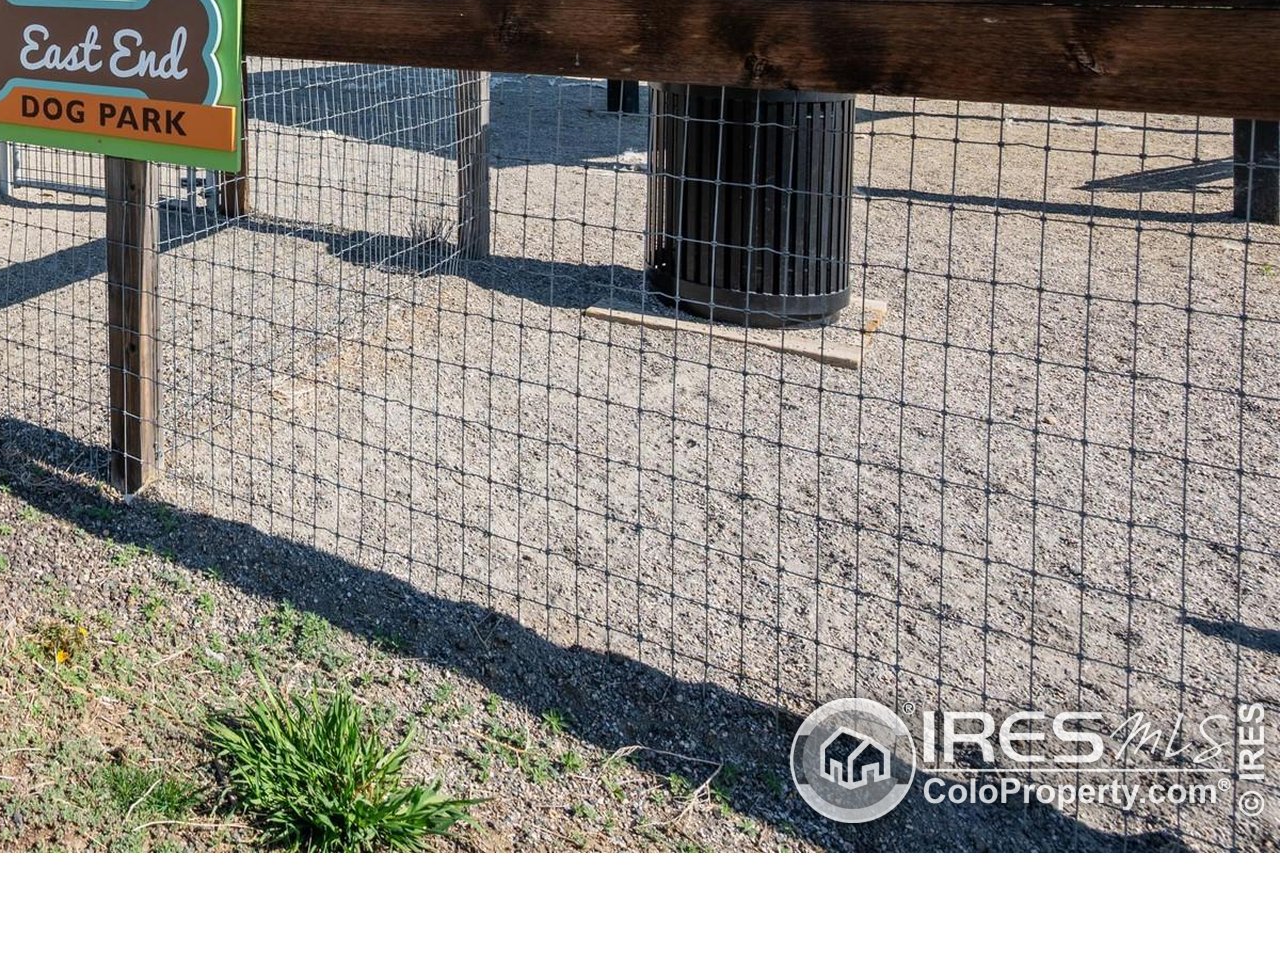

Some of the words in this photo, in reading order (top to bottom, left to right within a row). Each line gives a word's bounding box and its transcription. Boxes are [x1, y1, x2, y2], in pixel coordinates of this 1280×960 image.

[20, 24, 102, 72] East
[109, 25, 188, 80] End
[21, 95, 85, 123] DOG
[99, 103, 187, 136] PARK
